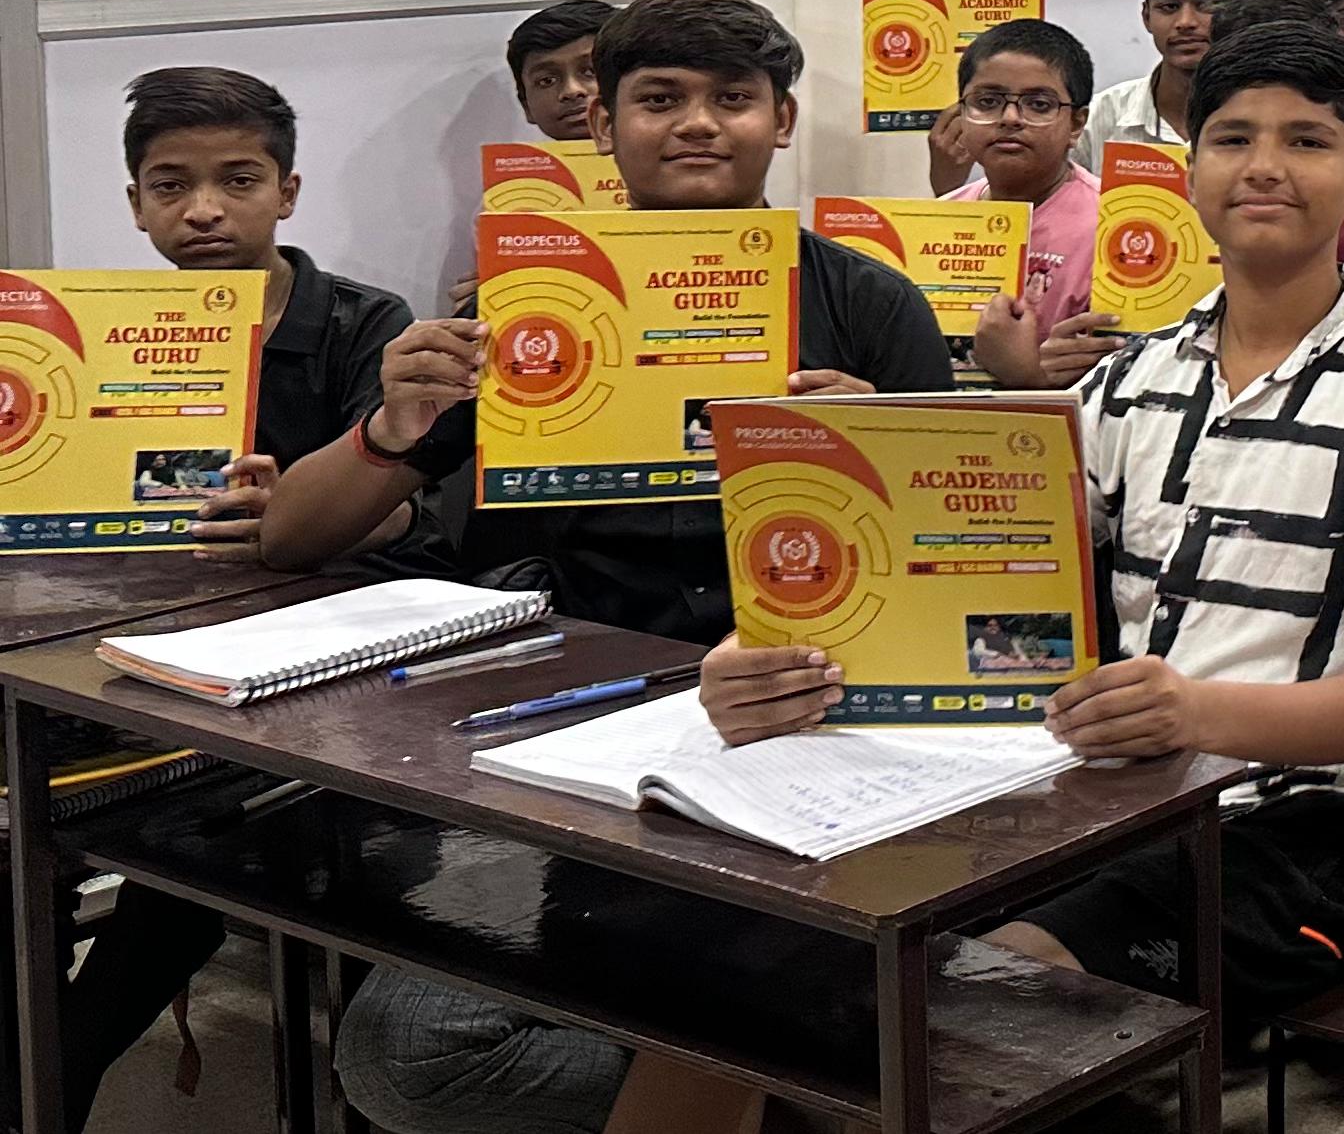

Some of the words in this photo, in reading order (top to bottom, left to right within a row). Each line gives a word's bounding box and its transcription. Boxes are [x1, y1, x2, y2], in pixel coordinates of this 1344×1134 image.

[974, 10, 1012, 21] GURU
[1115, 159, 1175, 172] PROSPECTUS
[497, 234, 580, 247] PROSPECTUS
[752, 232, 761, 243] 6
[920, 243, 1006, 257] ACADEMIC
[692, 255, 723, 266] THE
[938, 259, 985, 272] GURU
[646, 270, 769, 289] ACADEMIC
[0, 291, 42, 302] ECTUS
[675, 292, 740, 310] GURU
[154, 312, 186, 323] THE
[105, 327, 231, 344] ACADEMIC
[134, 348, 201, 364] GURU
[735, 426, 828, 441] PROSPECTUS
[957, 454, 992, 467] THE
[910, 470, 1047, 491] ACADEMIC
[944, 494, 1018, 513] GURU
